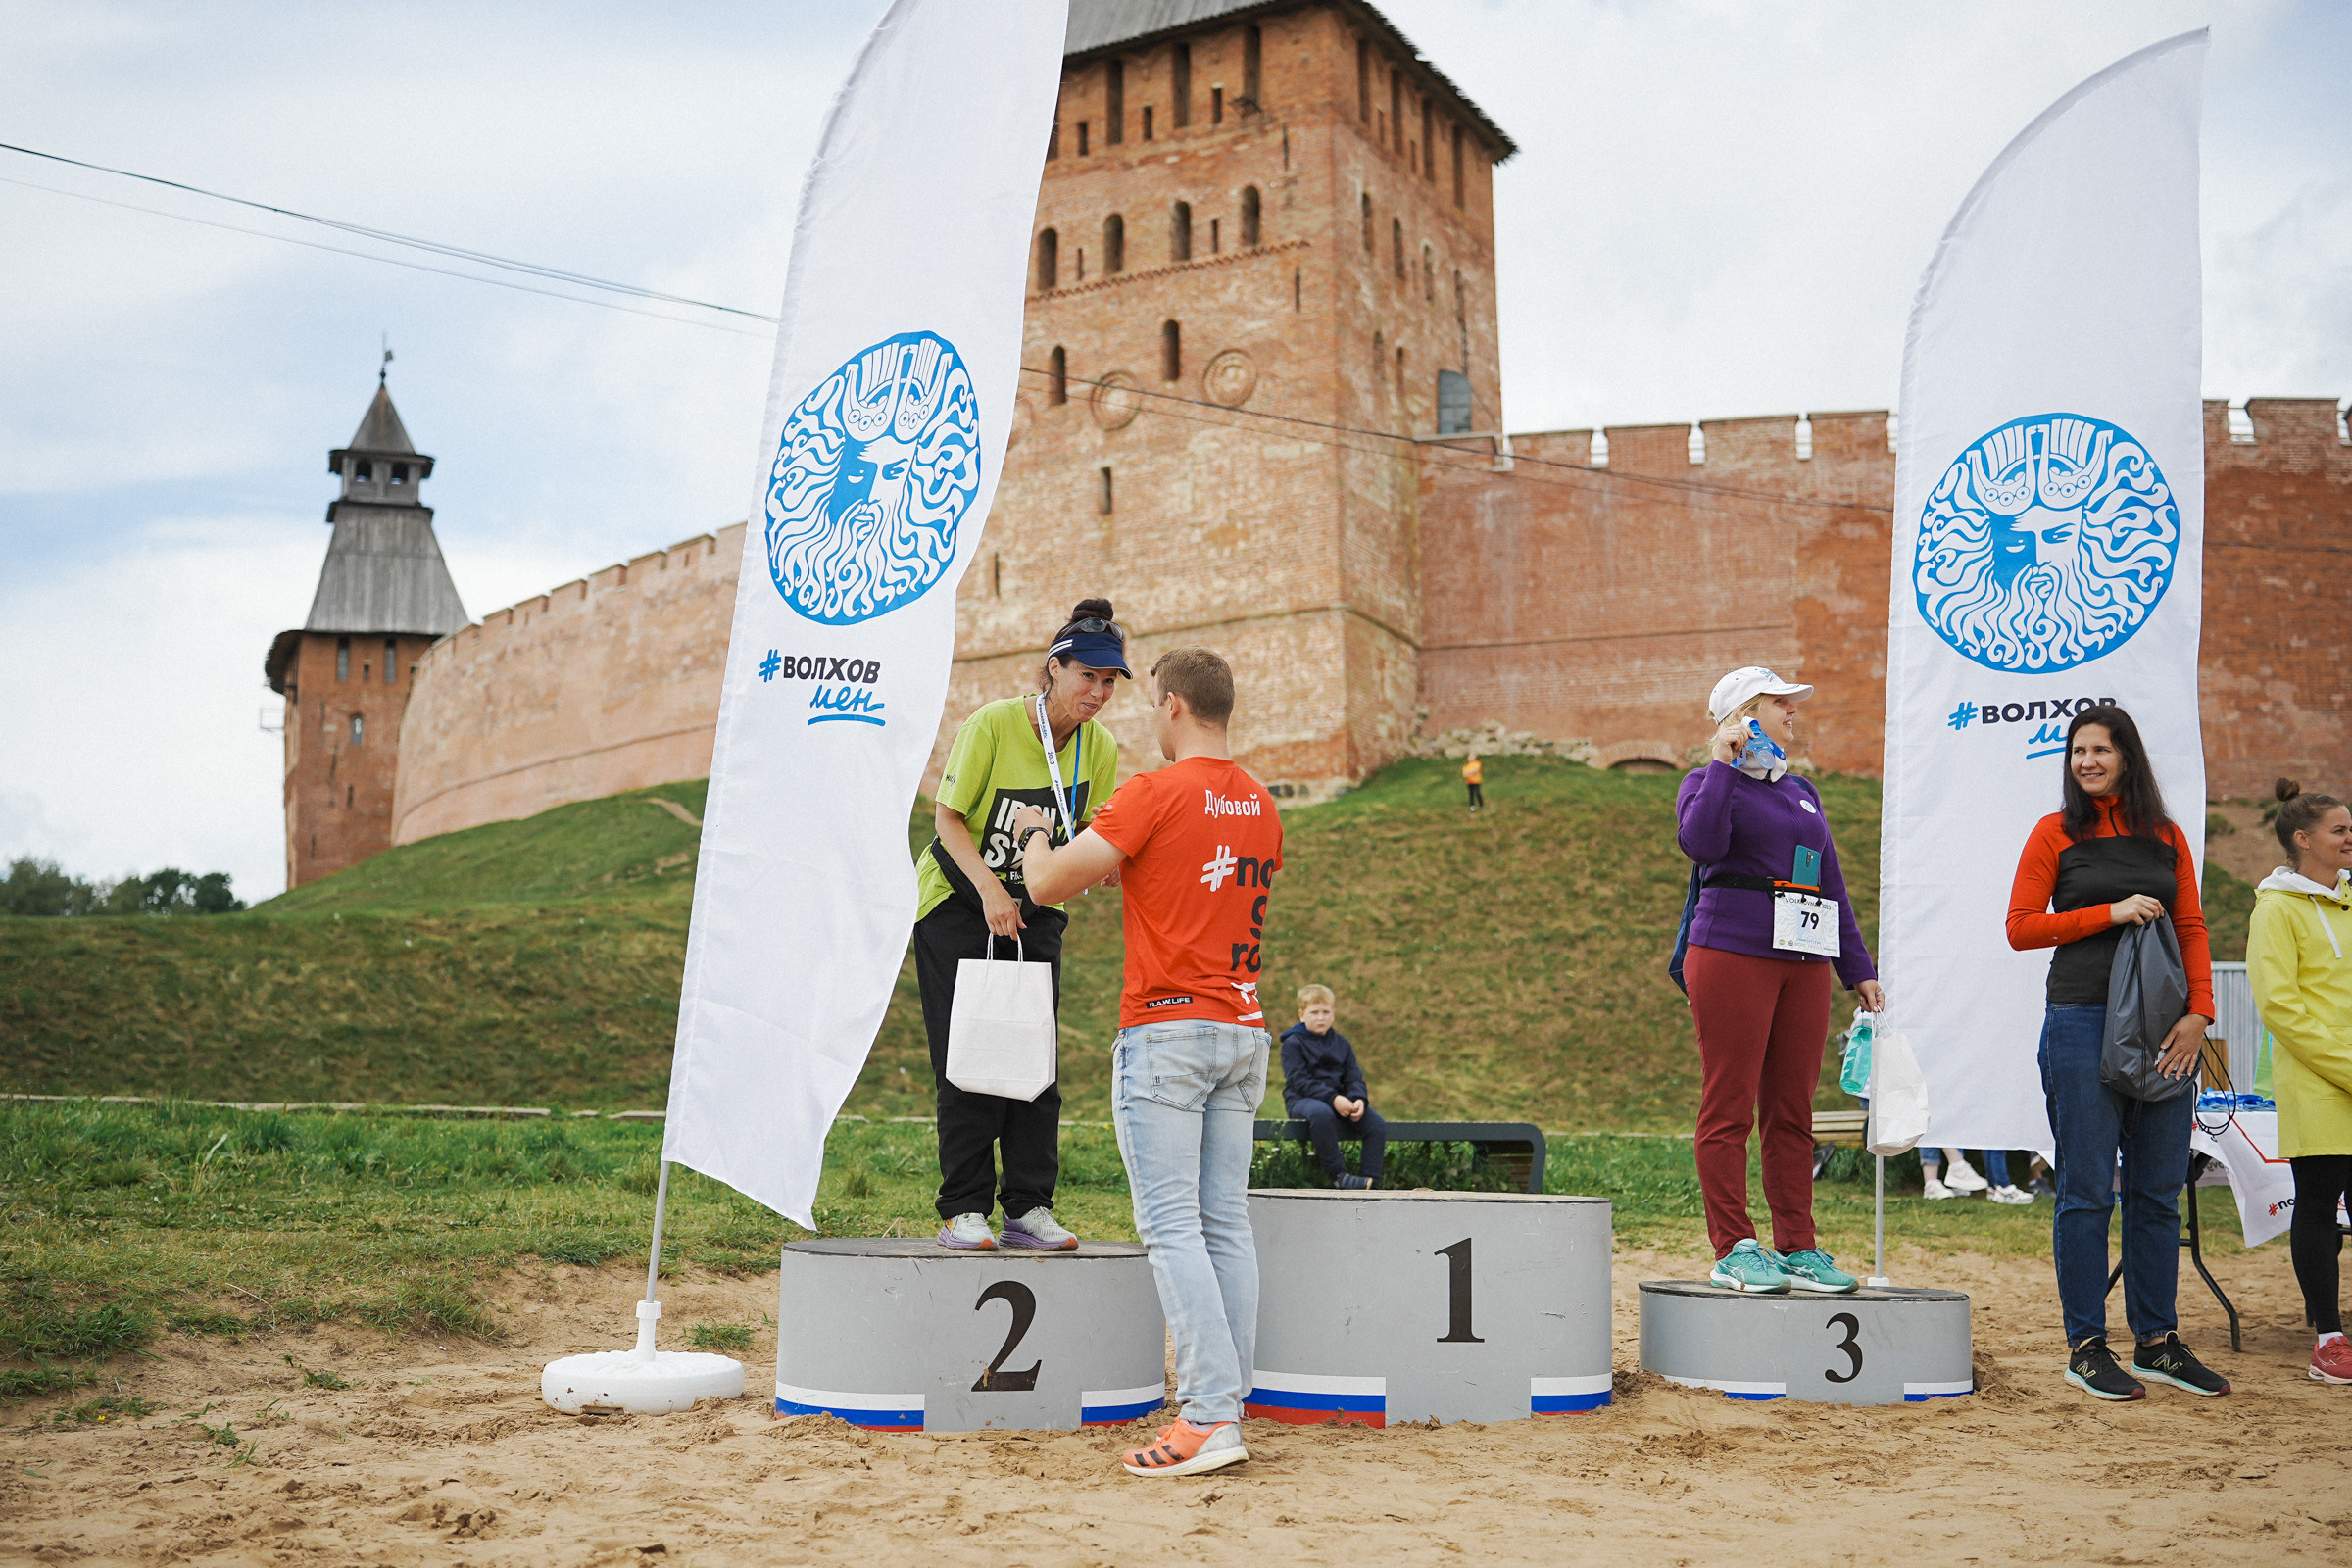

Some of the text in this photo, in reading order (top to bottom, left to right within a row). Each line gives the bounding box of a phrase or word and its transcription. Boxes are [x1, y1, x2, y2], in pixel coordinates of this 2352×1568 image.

[759, 649, 881, 683] #ВОЛХОВ
[1047, 751, 1055, 765] 2023
[994, 797, 1057, 843] IRN
[1204, 789, 1261, 819] Дубовой
[1800, 910, 1820, 930] 79
[1434, 1237, 1485, 1343] 1
[970, 1280, 1043, 1392] 2
[1825, 1312, 1863, 1383] 3
